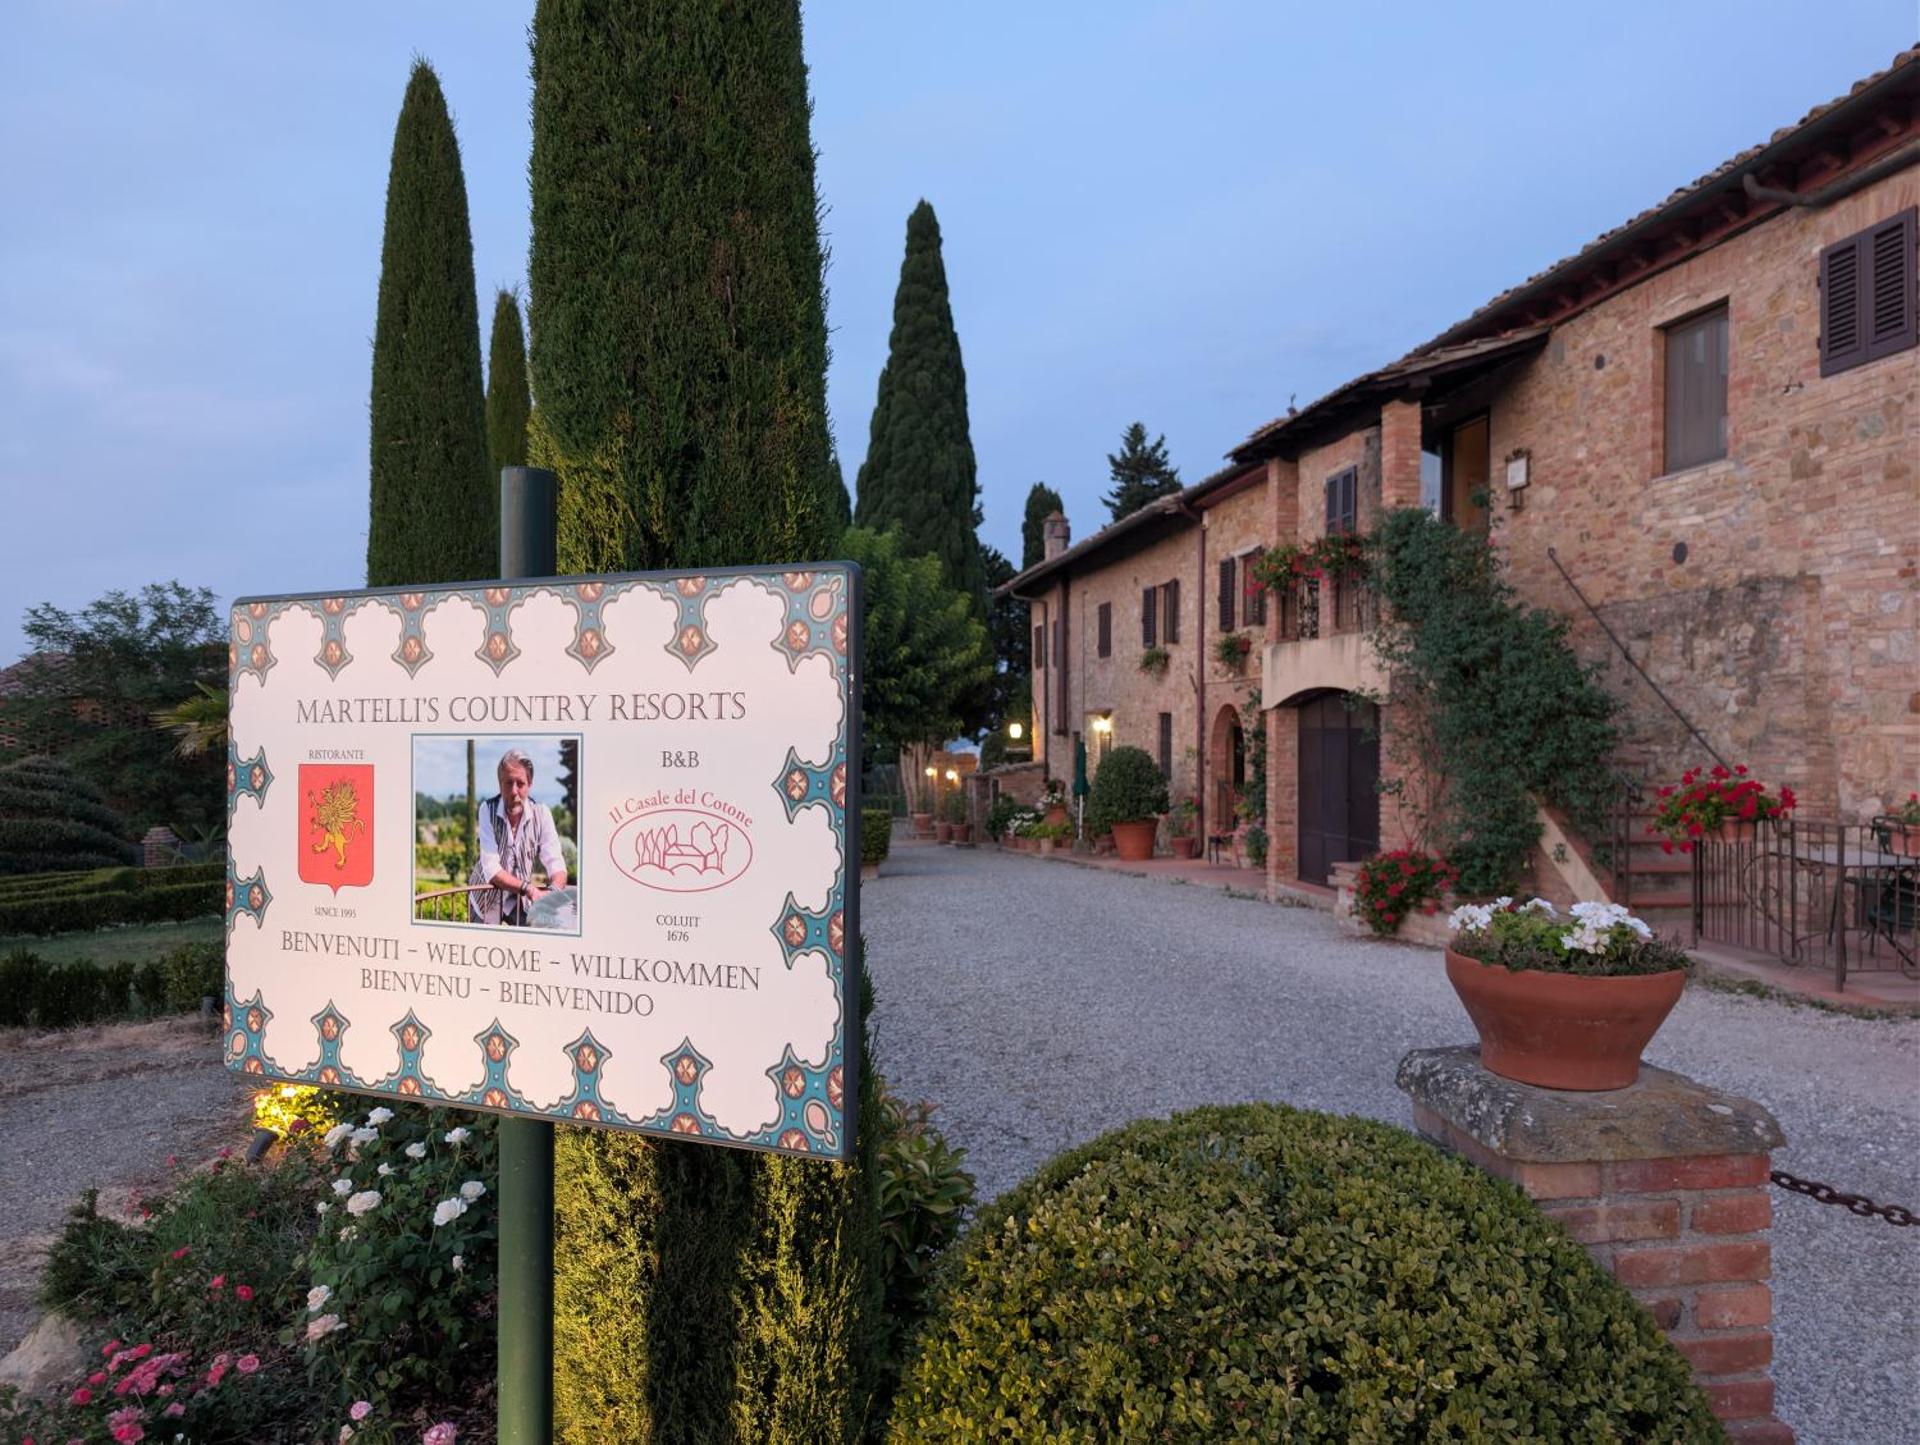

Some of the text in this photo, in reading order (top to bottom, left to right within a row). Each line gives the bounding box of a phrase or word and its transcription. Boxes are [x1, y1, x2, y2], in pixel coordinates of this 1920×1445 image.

[297, 691, 747, 724] MARTELLI'S COUNTRY RESORTS
[308, 749, 365, 760] RISTORANTE
[662, 751, 700, 768] B&B
[625, 790, 670, 814] Casale
[674, 788, 696, 805] del
[701, 791, 754, 828] Cotone
[314, 907, 337, 917] SINCE
[656, 915, 701, 928] COLUIT
[667, 930, 690, 942] 1676
[282, 931, 399, 960] BENVENUTI
[427, 942, 541, 973] WELCOME
[571, 953, 761, 991] WILLKOMMEN
[360, 968, 471, 999] BIENVENU
[499, 981, 654, 1017] BIENVENIDO
